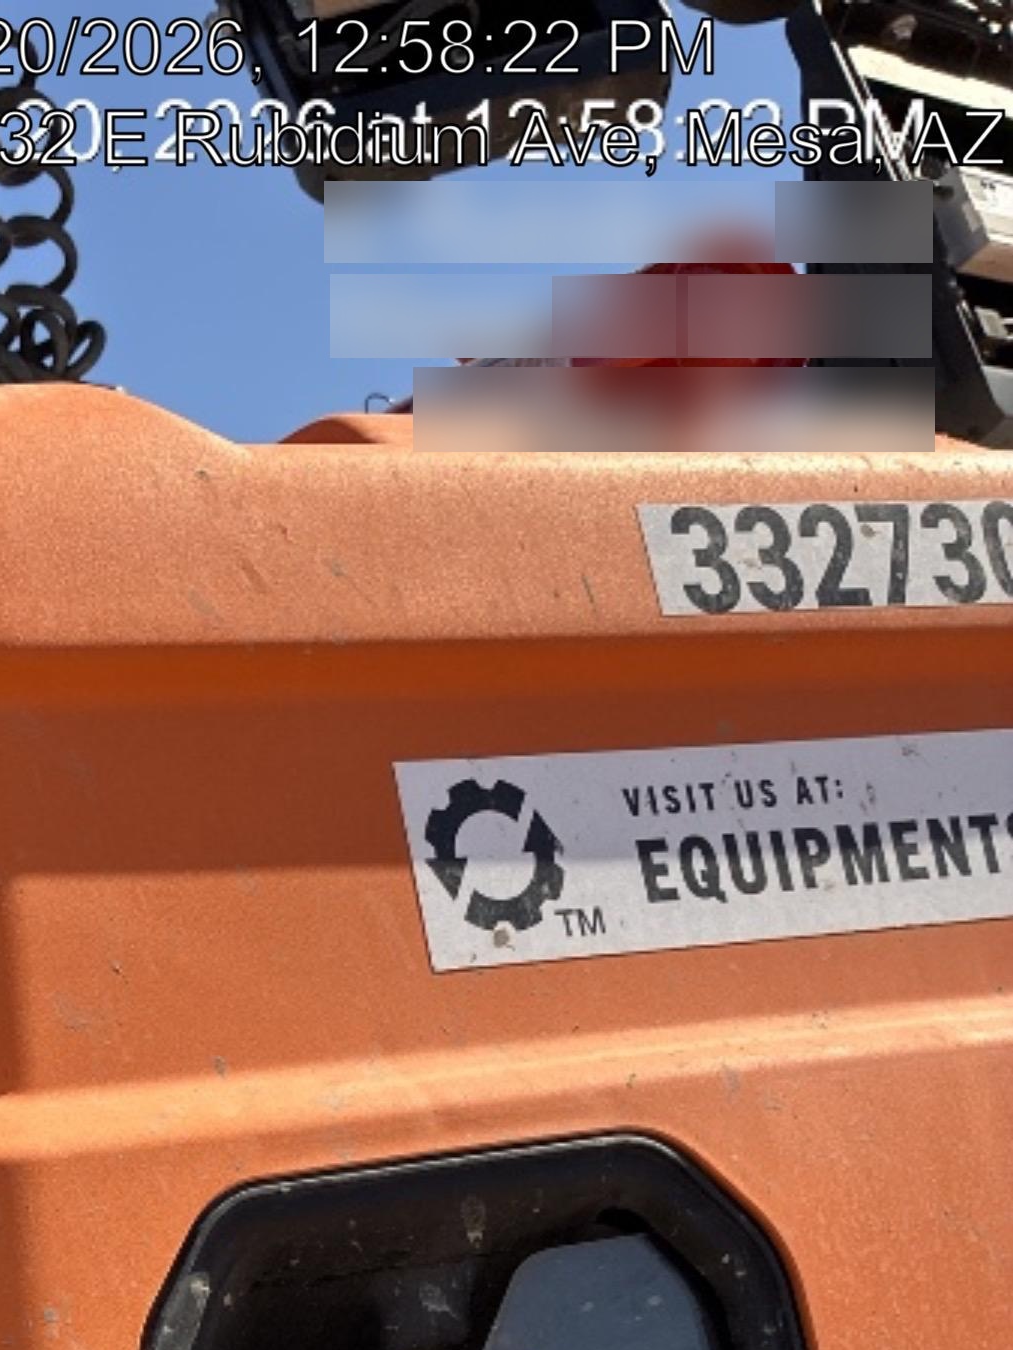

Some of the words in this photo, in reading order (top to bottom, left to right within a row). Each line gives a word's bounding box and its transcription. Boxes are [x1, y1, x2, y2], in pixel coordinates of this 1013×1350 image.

[622, 781, 716, 817] VISIT
[734, 778, 778, 809] US
[795, 774, 845, 805] AT:
[554, 905, 606, 937] TM
